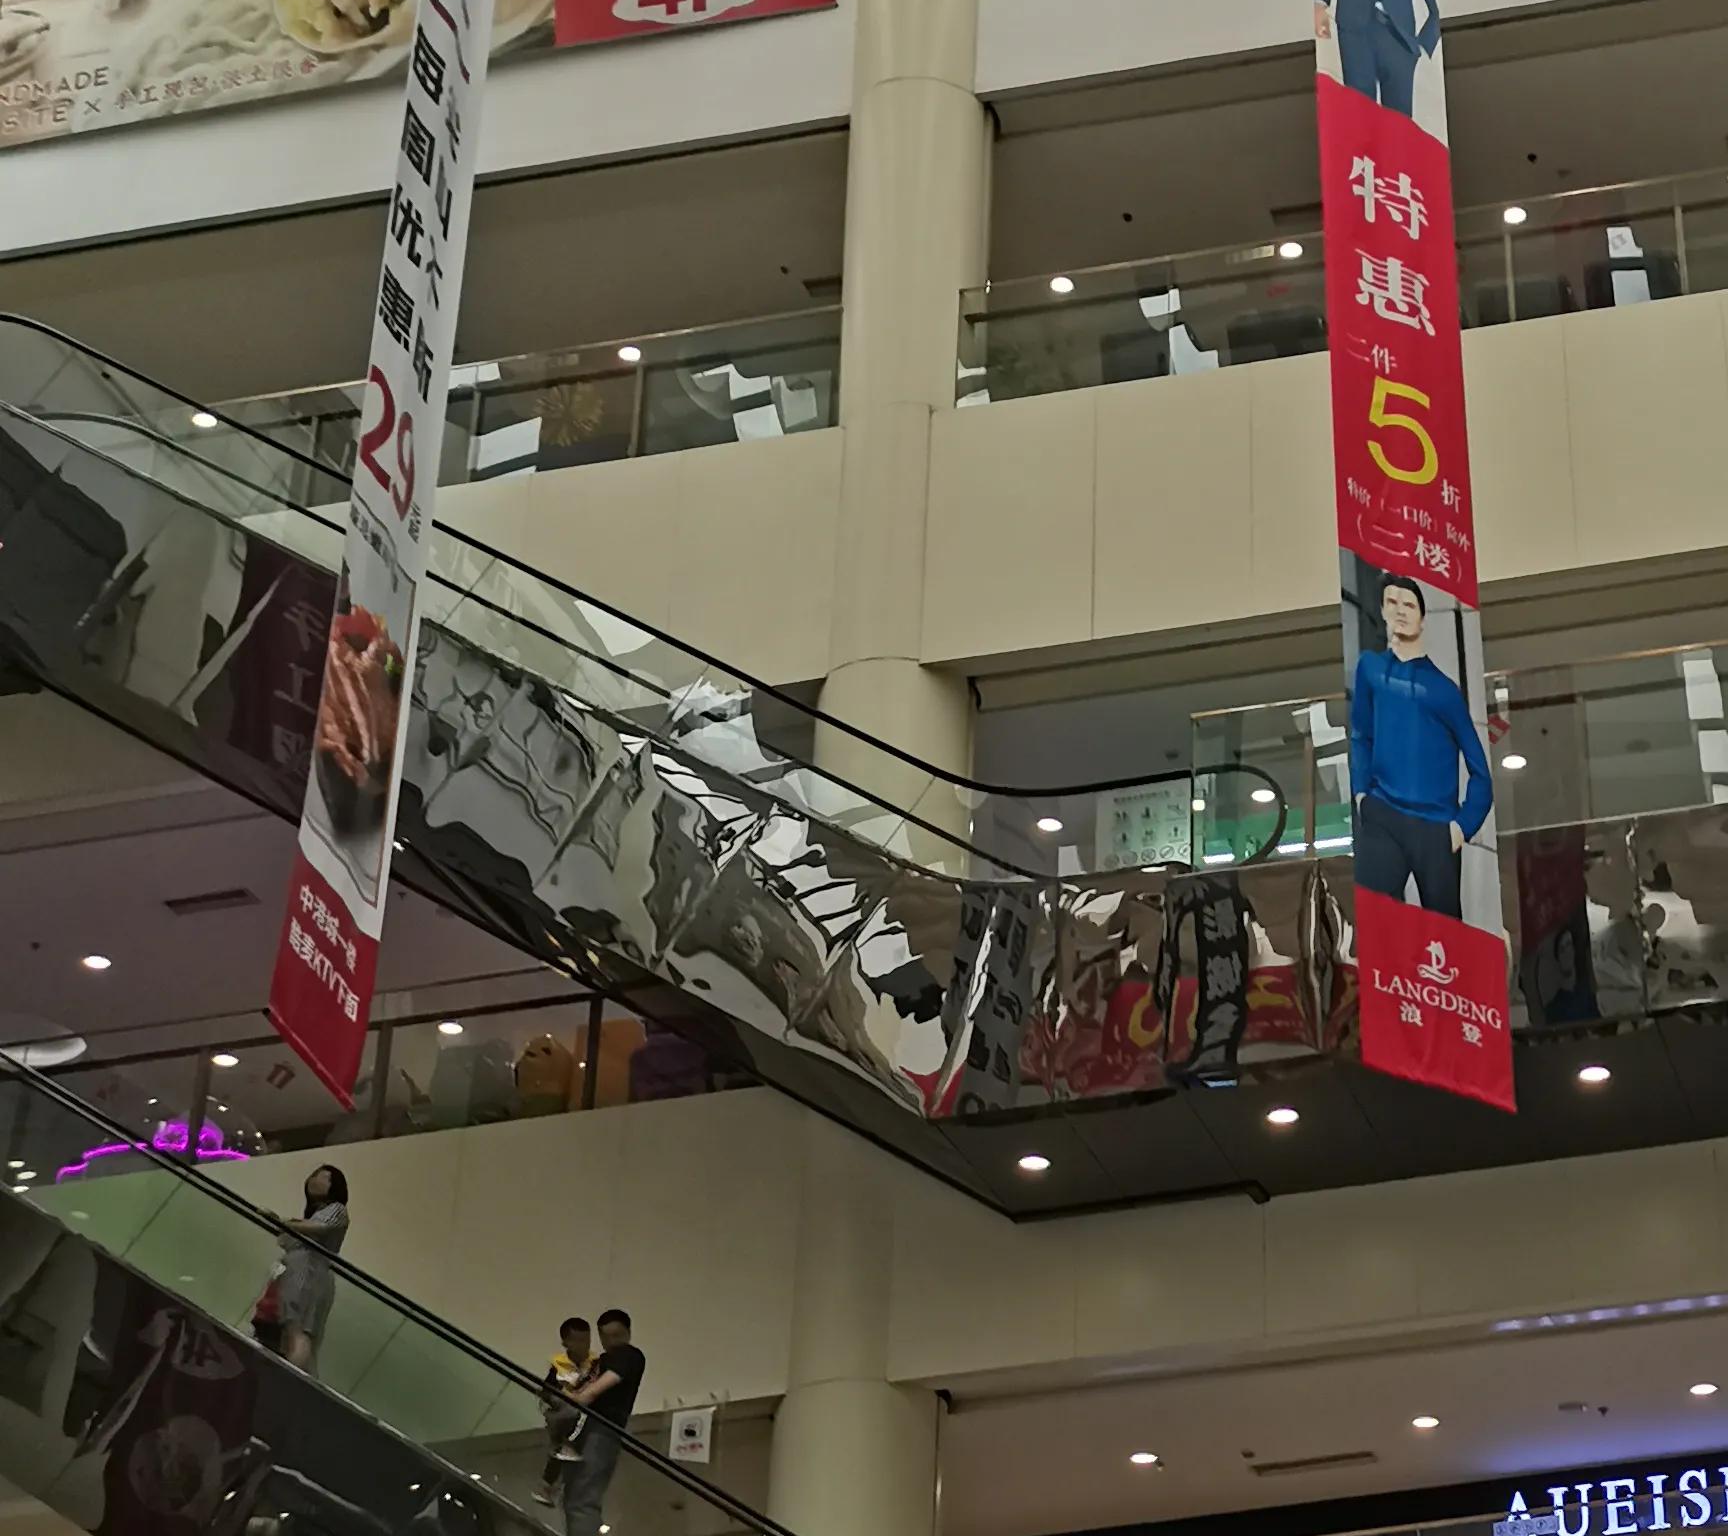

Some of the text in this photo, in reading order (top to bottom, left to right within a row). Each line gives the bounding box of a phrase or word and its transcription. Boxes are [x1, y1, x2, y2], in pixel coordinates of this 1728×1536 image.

[1349, 154, 1436, 338] 特惠
[359, 364, 415, 523] 29
[1367, 375, 1439, 486] 5
[1373, 967, 1503, 1030] LANGDENG
